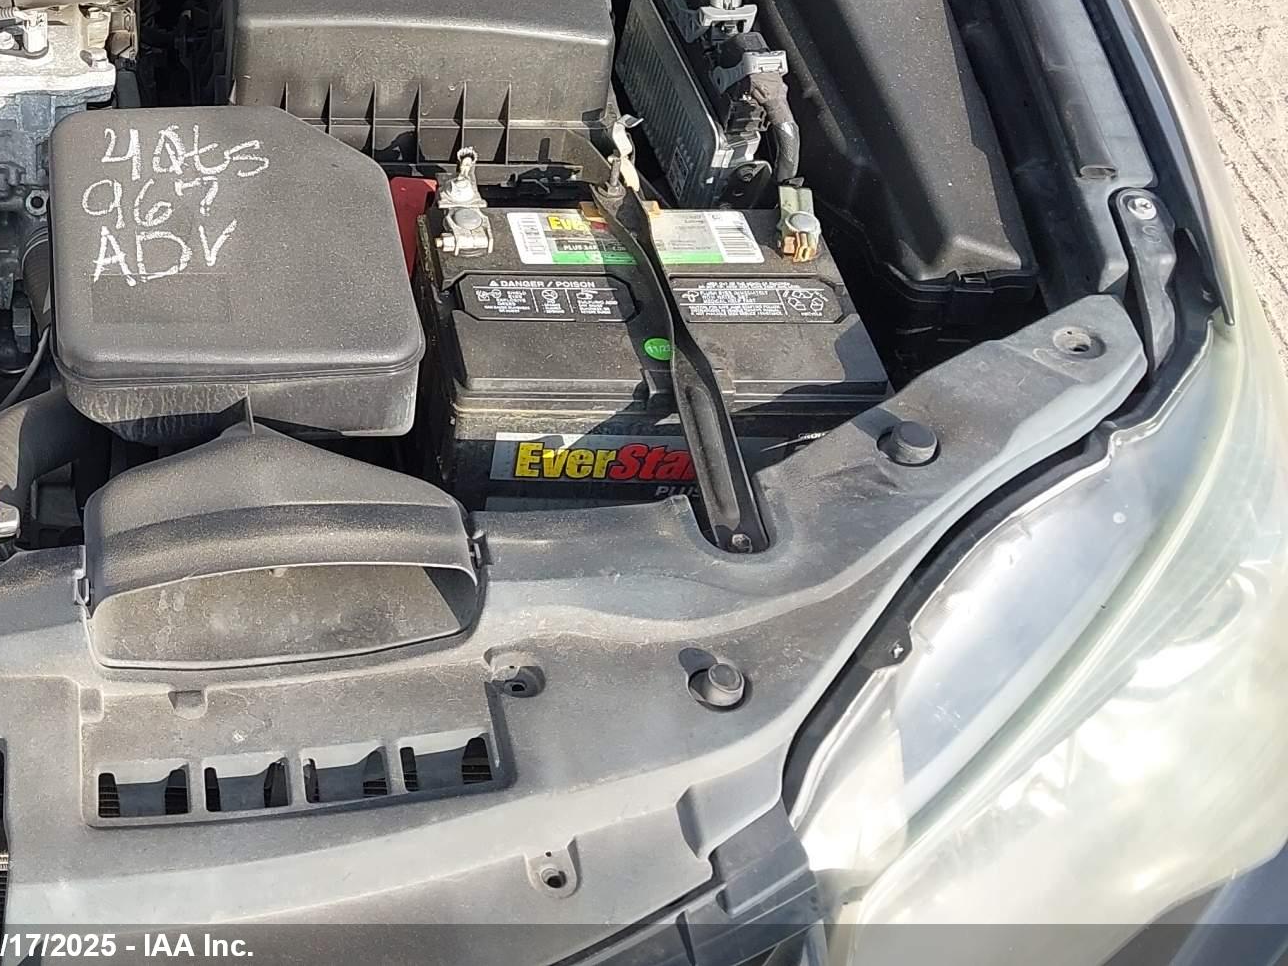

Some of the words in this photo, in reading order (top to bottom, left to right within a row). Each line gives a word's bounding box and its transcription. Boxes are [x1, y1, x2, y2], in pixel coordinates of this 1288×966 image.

[82, 175, 219, 229] 967
[93, 219, 238, 286] ADV
[500, 280, 545, 288] DANGER
[513, 442, 697, 481] EverSta
